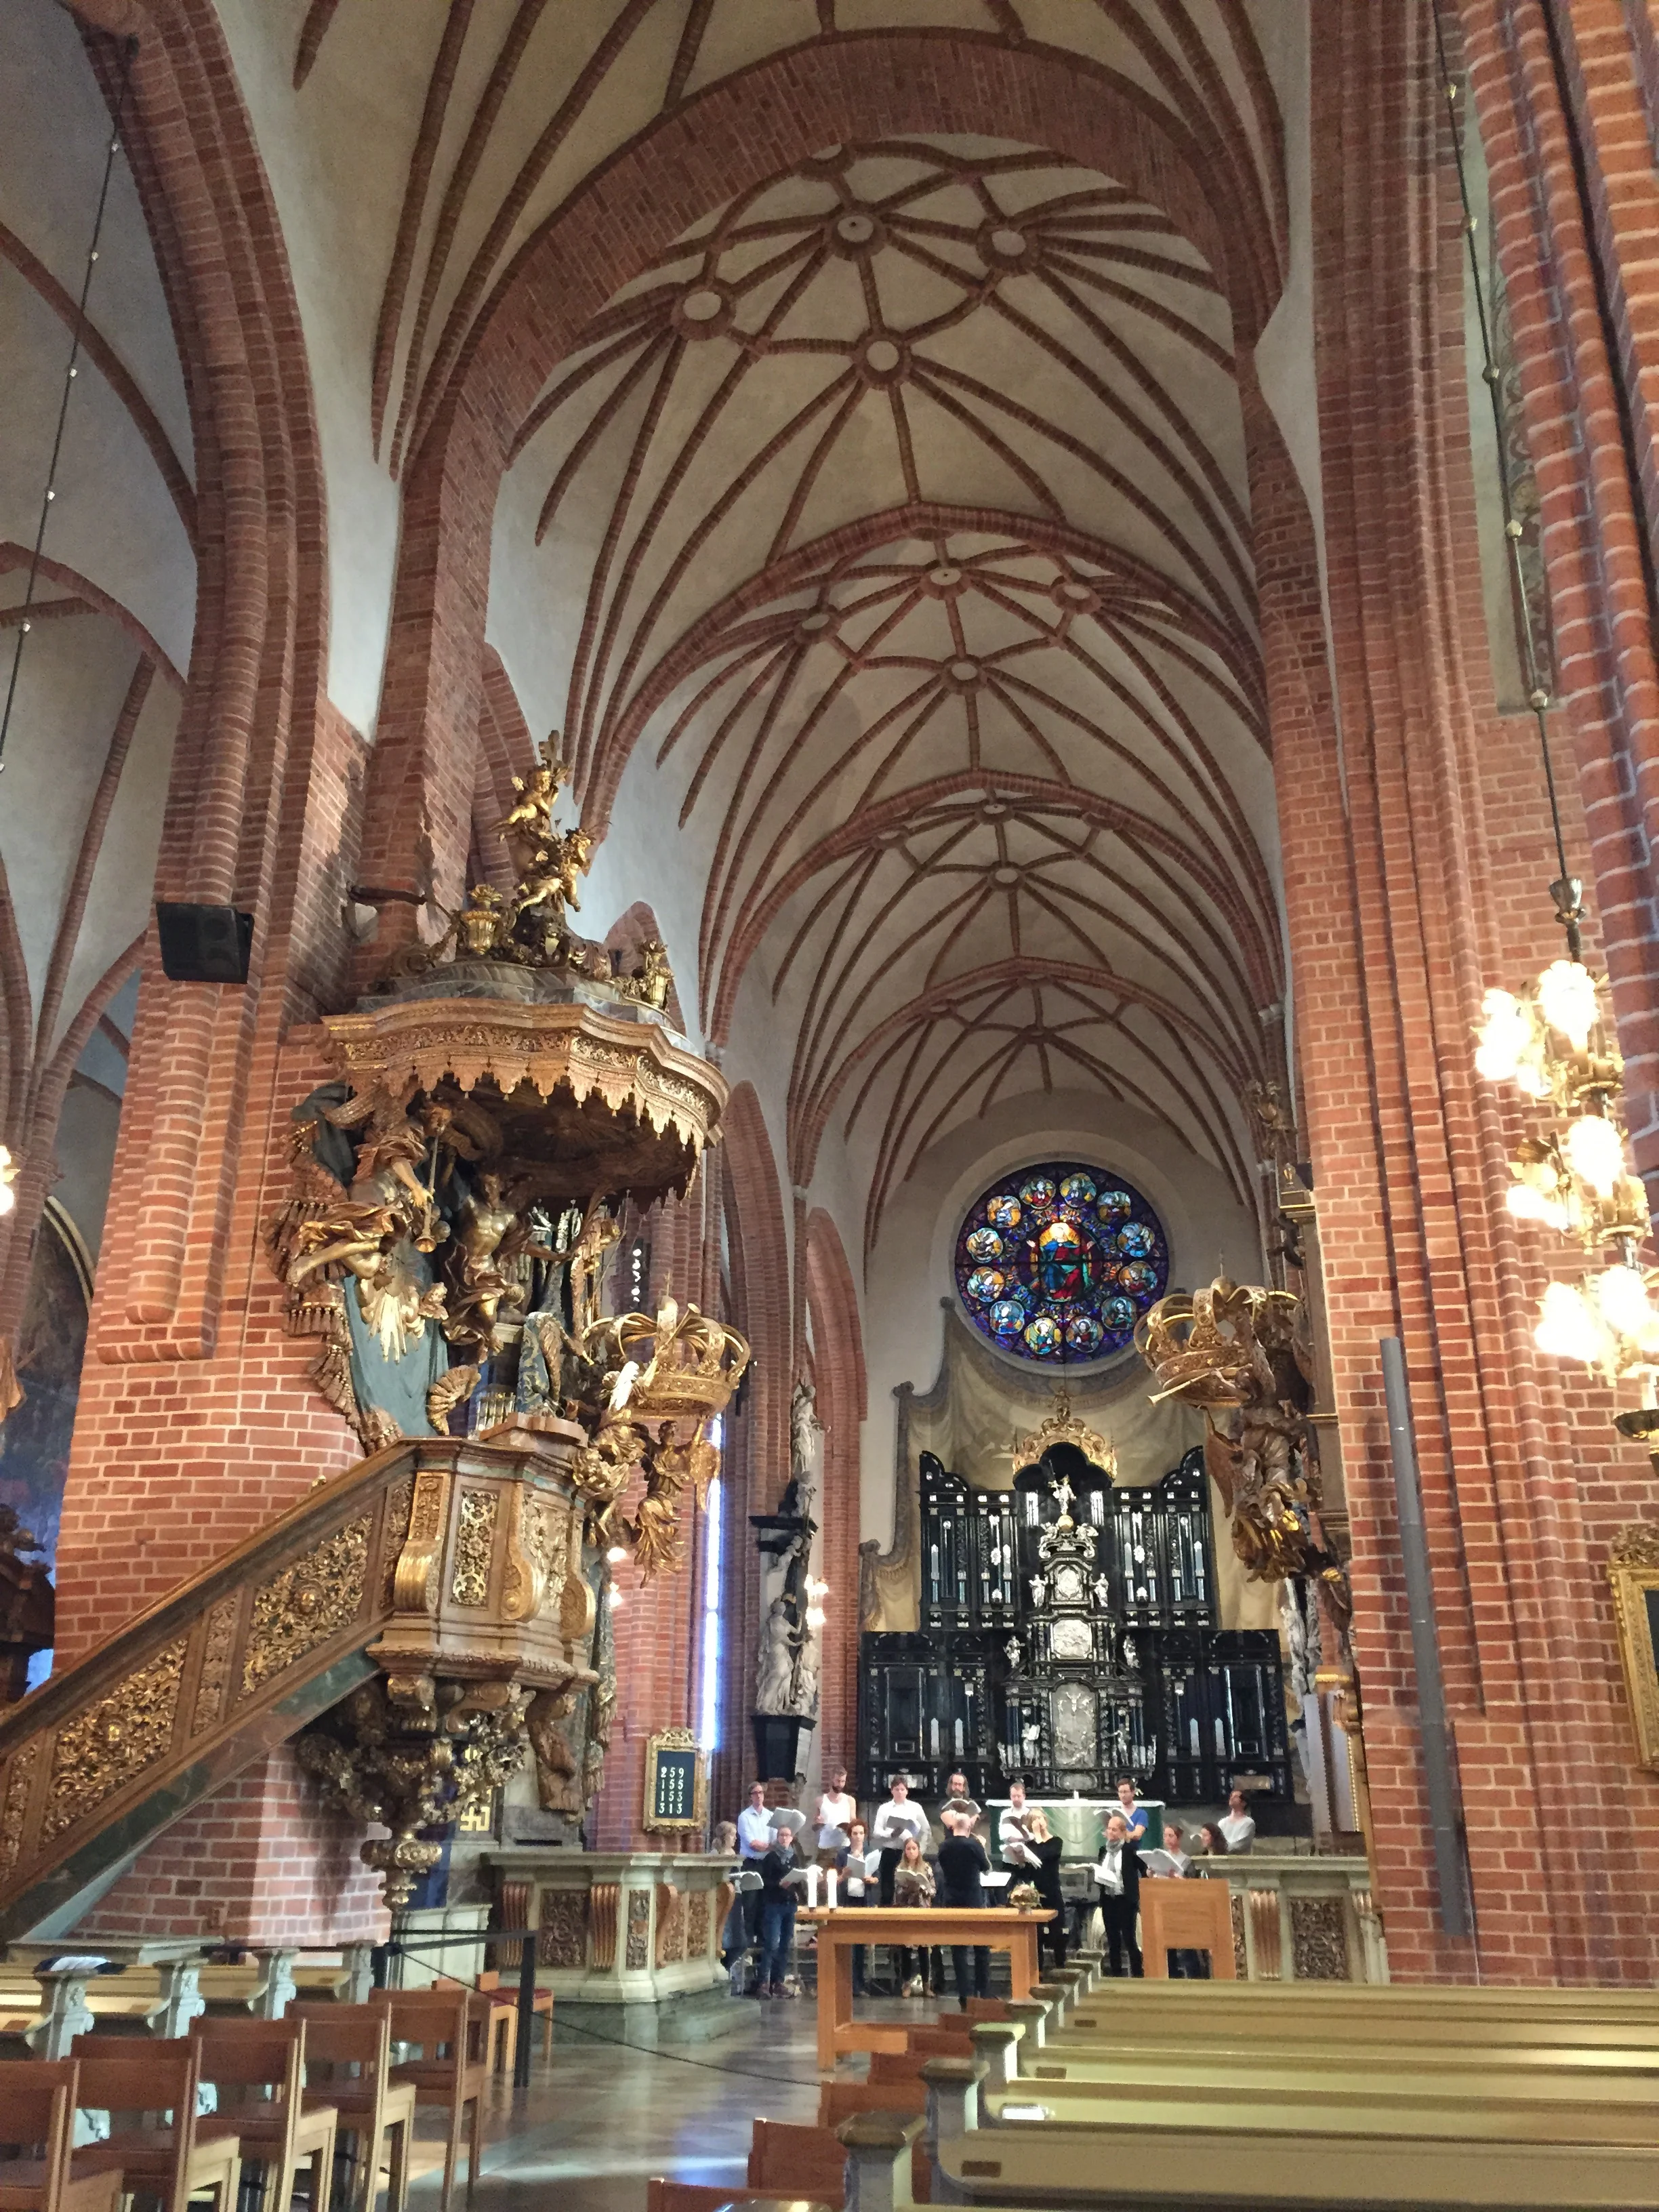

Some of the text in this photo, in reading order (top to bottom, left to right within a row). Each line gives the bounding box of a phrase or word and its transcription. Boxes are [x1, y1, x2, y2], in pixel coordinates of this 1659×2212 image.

[661, 1766, 684, 1778] 259
[661, 1778, 684, 1790] 155
[660, 1790, 683, 1802] 153
[659, 1803, 682, 1814] 313
